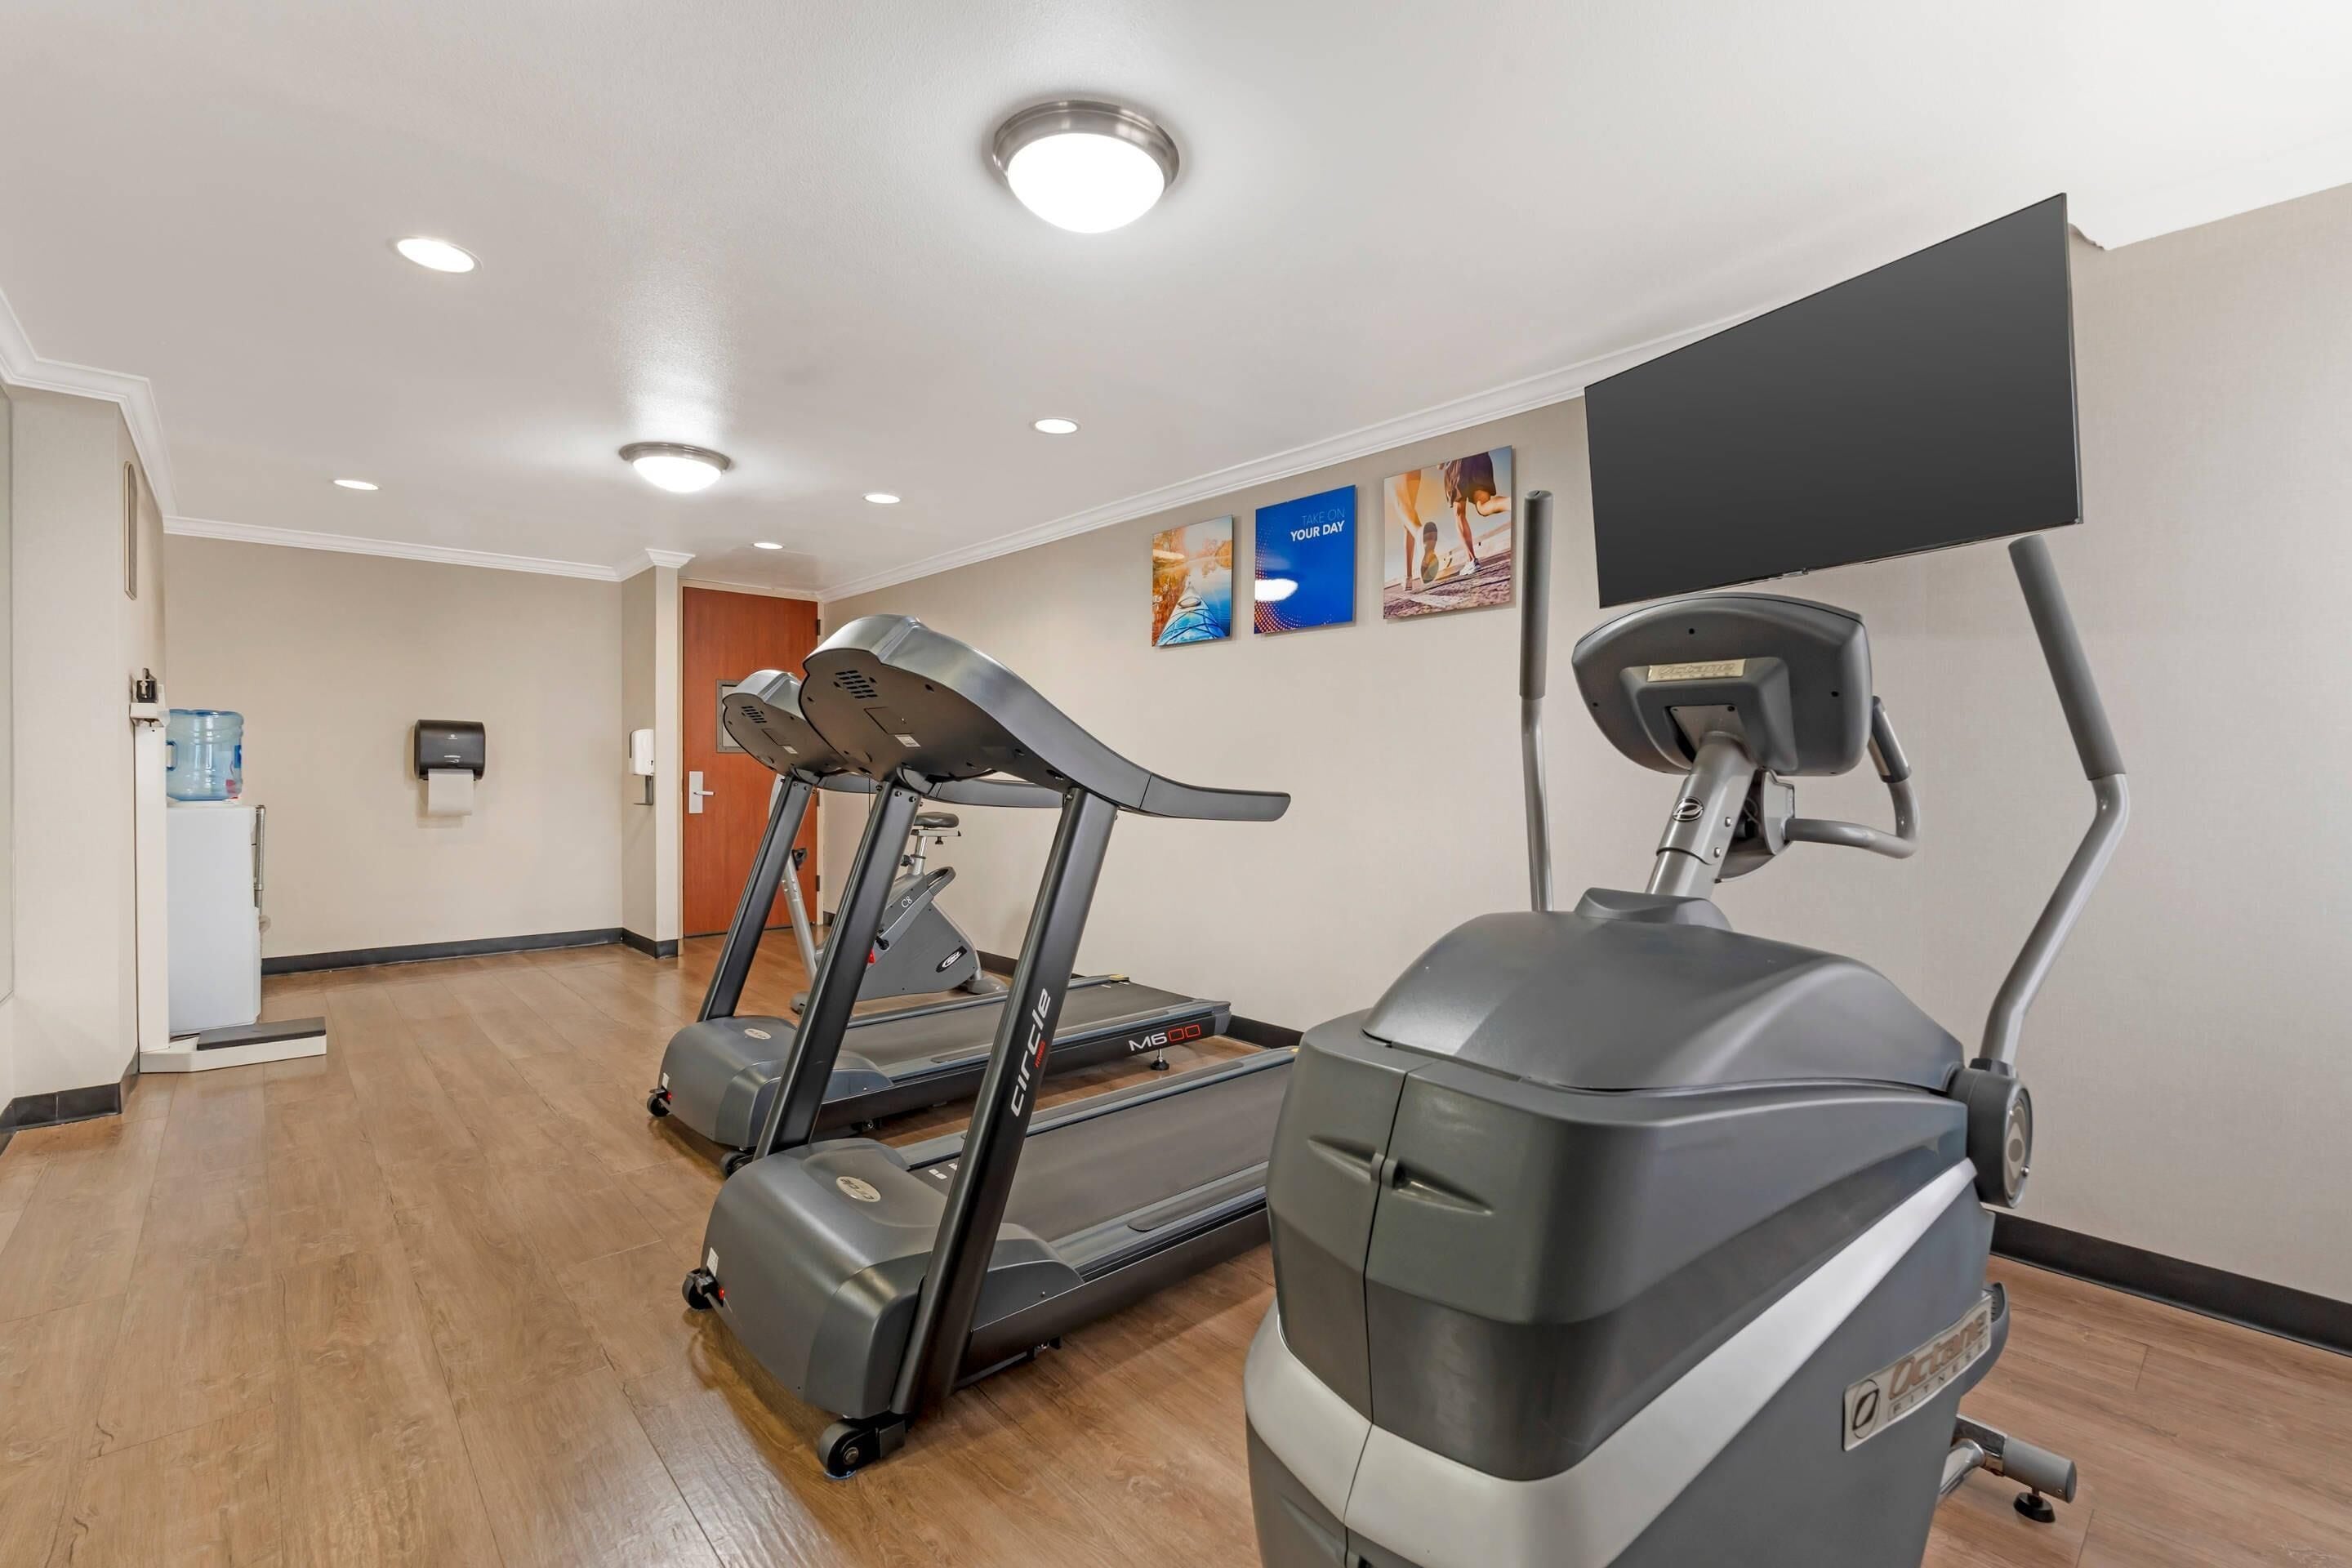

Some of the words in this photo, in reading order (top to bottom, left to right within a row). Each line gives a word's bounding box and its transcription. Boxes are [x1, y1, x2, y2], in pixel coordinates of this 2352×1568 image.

[1302, 511, 1325, 527] TAKE
[1327, 508, 1345, 521] ON
[1290, 526, 1320, 541] YOUR
[1323, 520, 1345, 535] DAY
[1129, 1024, 1201, 1051] M600
[1011, 988, 1051, 1117] circle
